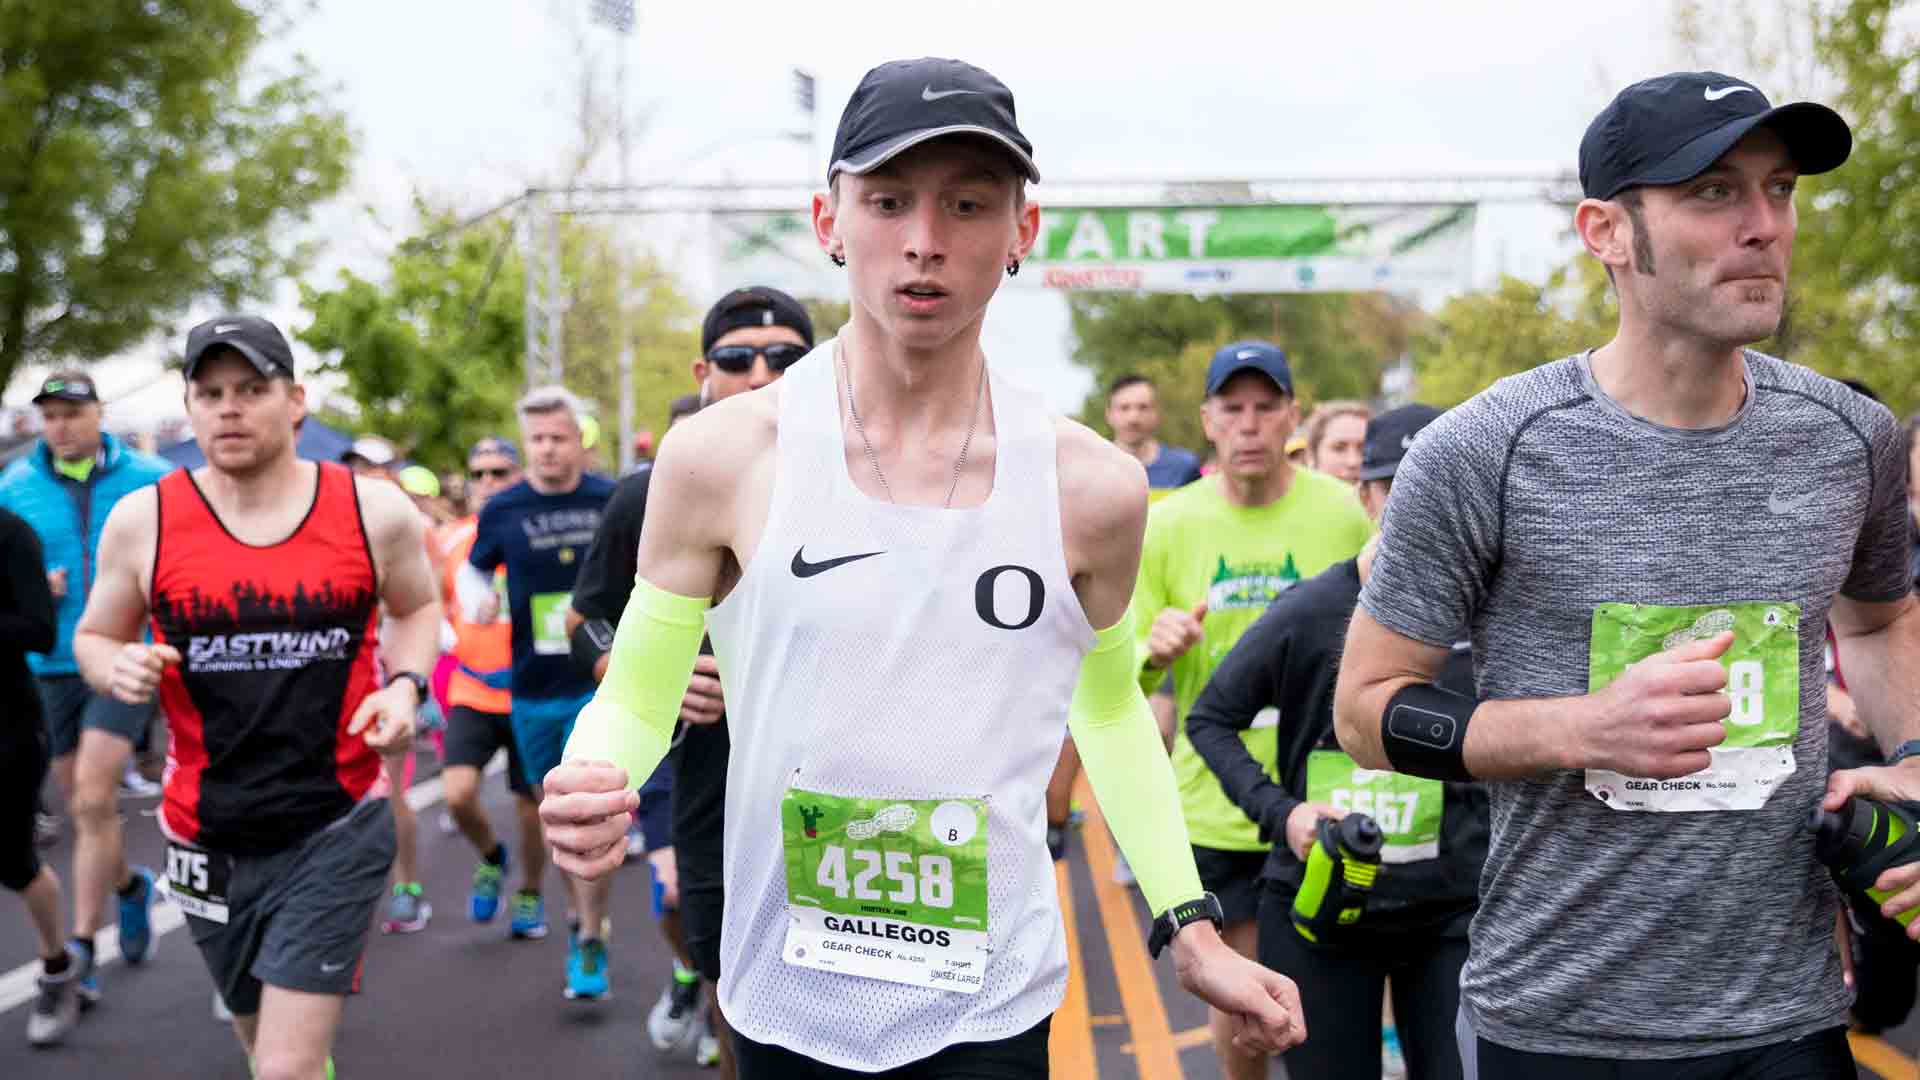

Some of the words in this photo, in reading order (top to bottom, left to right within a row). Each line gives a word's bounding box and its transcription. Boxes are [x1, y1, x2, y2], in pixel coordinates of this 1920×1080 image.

[1038, 209, 1217, 257] TART
[975, 565, 1045, 630] O
[1767, 613, 1775, 622] A
[1624, 781, 1658, 791] GEAR
[1660, 781, 1701, 791] CHECK
[948, 829, 957, 841] B
[817, 846, 954, 909] 4258
[824, 916, 950, 947] GALLEGOS
[822, 940, 852, 953] GEAR
[855, 945, 892, 959] CHECK
